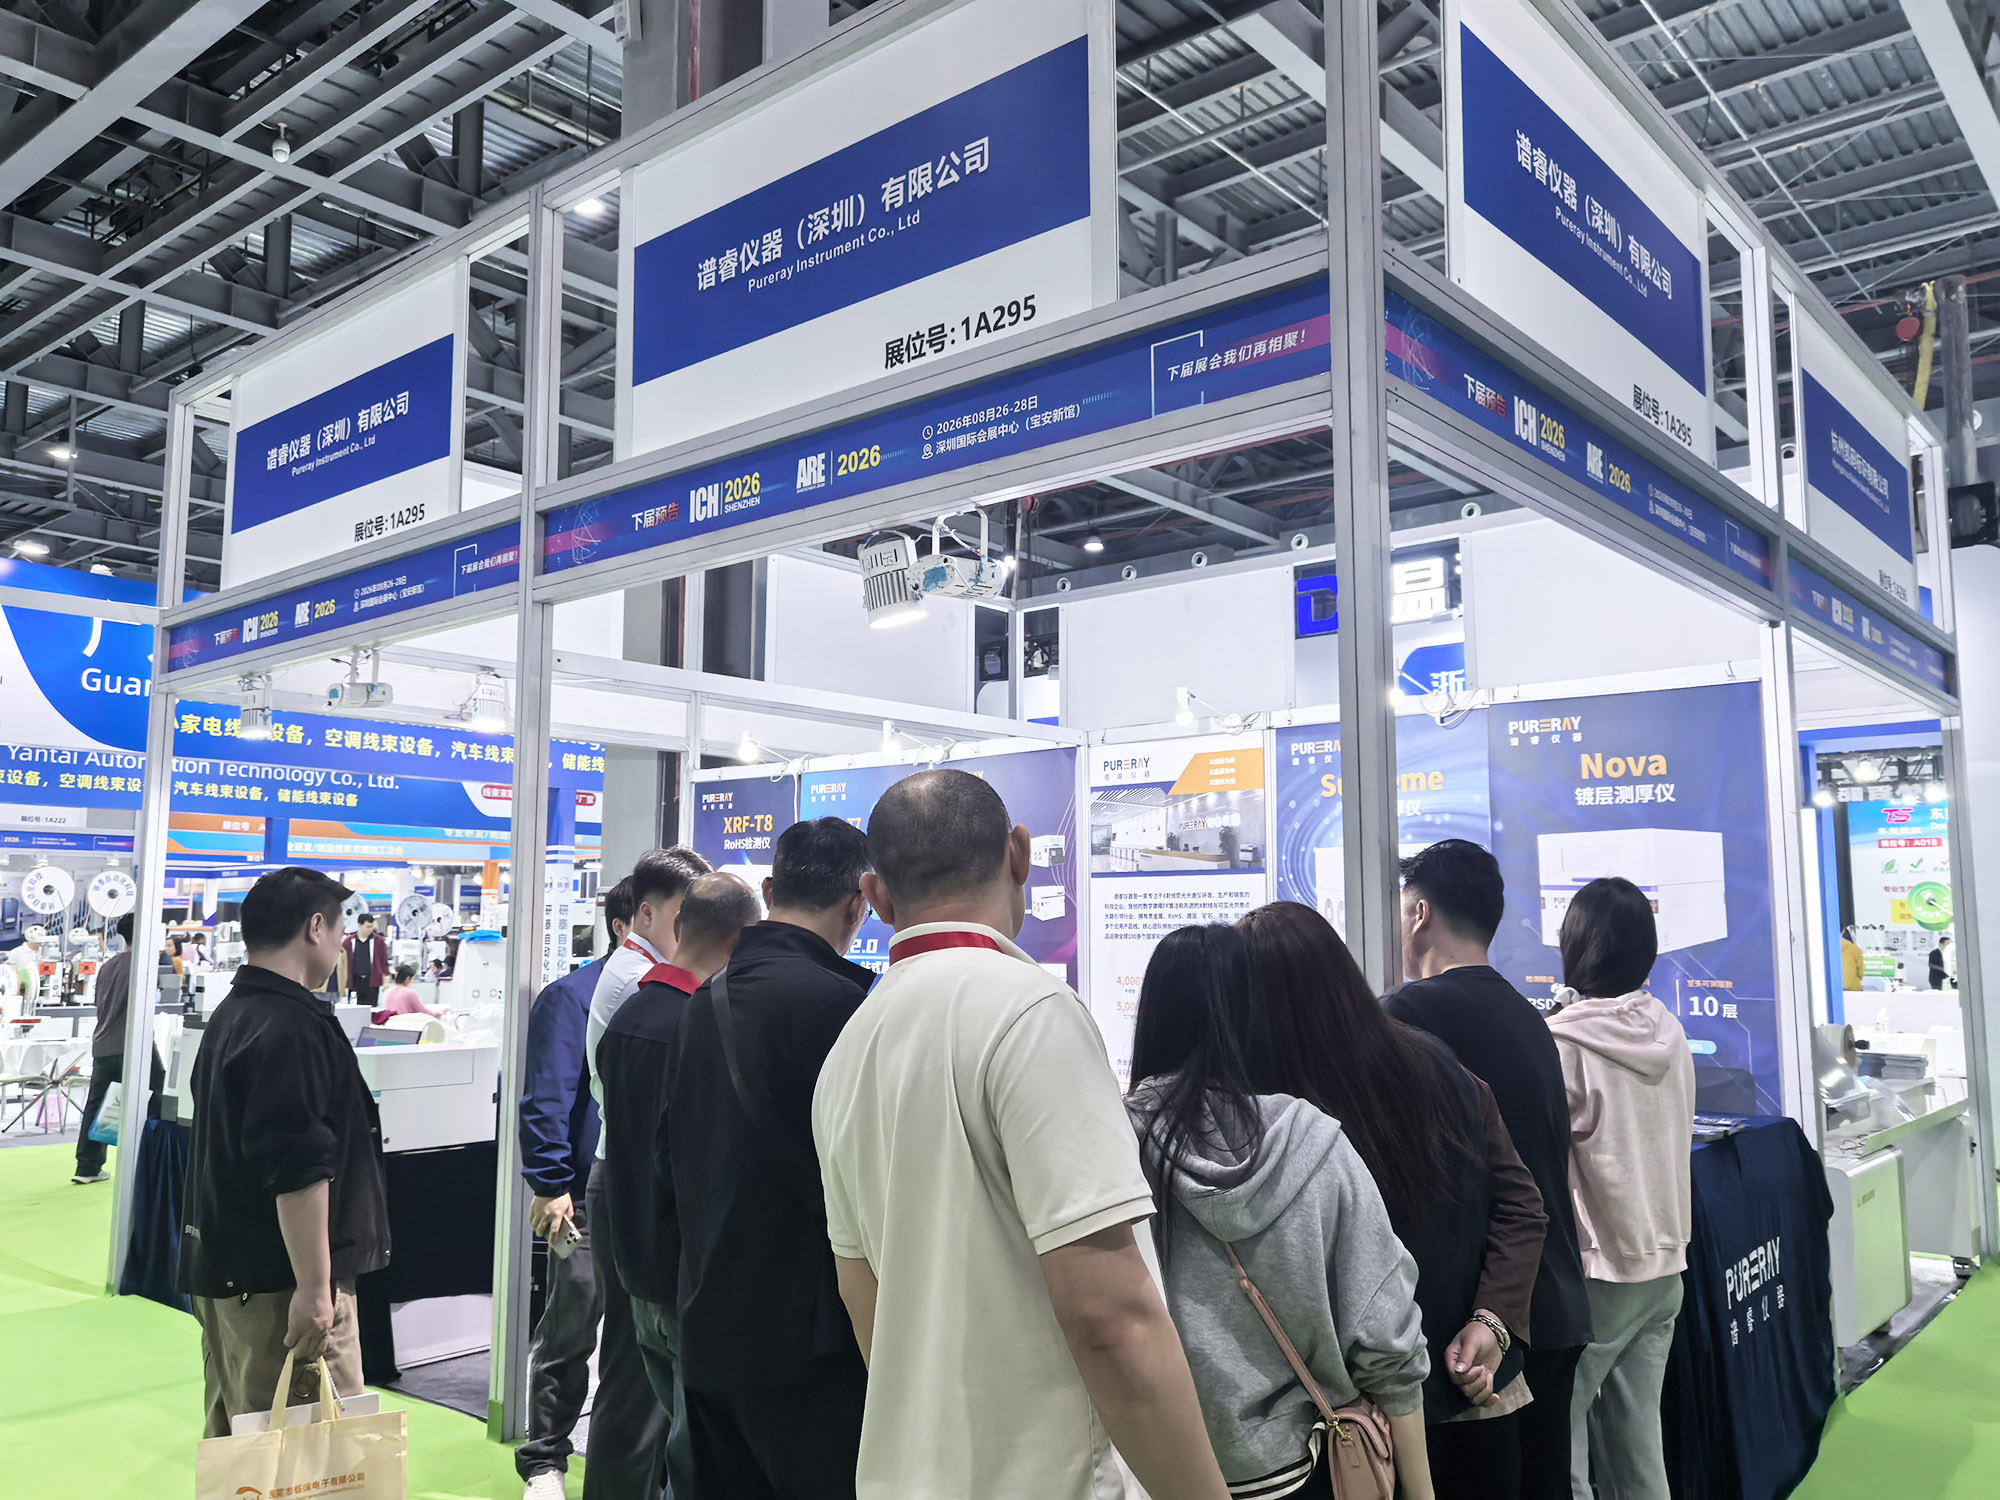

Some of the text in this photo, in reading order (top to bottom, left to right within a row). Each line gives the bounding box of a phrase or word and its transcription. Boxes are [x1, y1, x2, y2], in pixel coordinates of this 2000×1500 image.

[697, 136, 990, 292] 谱睿仪器（深圳）有限公司
[1516, 129, 1673, 300] 谱睿仪器（深圳）有限公司
[748, 209, 921, 292] Pureray Instrument Co., Ltd
[1555, 206, 1585, 245] Pureray
[1586, 232, 1623, 277] Instrument
[1637, 278, 1648, 298] Ltd
[1463, 373, 1507, 420] 下届预告
[936, 395, 1039, 435] 2026年08月26-28日
[1513, 395, 1566, 450] ICH 2026
[266, 390, 410, 471] 谱睿仪器（深圳）有限公司
[292, 459, 315, 477] Pureray
[315, 445, 350, 467] Instrument
[364, 434, 376, 447] Ltd
[796, 444, 881, 490] ARE 2026
[1608, 463, 1632, 495] 2026
[689, 472, 761, 523] ICH 2026
[724, 496, 761, 514] SHENZHEN
[631, 502, 680, 531] 下届预告
[260, 611, 279, 631] 2026
[314, 599, 336, 619] 2026
[1508, 715, 1582, 735] PURERAY
[1103, 757, 1150, 772] PURERAY
[1580, 753, 1668, 780] Nova
[368, 774, 400, 790] Ltd.
[811, 782, 846, 795] PURERAY
[1574, 783, 1676, 806] 镀层测厚仪
[702, 792, 733, 804] PURERAY
[723, 814, 774, 834] XRF-T8
[724, 837, 771, 850] RoHS检测仪
[1689, 996, 1738, 1019] 10 层
[1725, 1237, 1780, 1310] PURERAY
